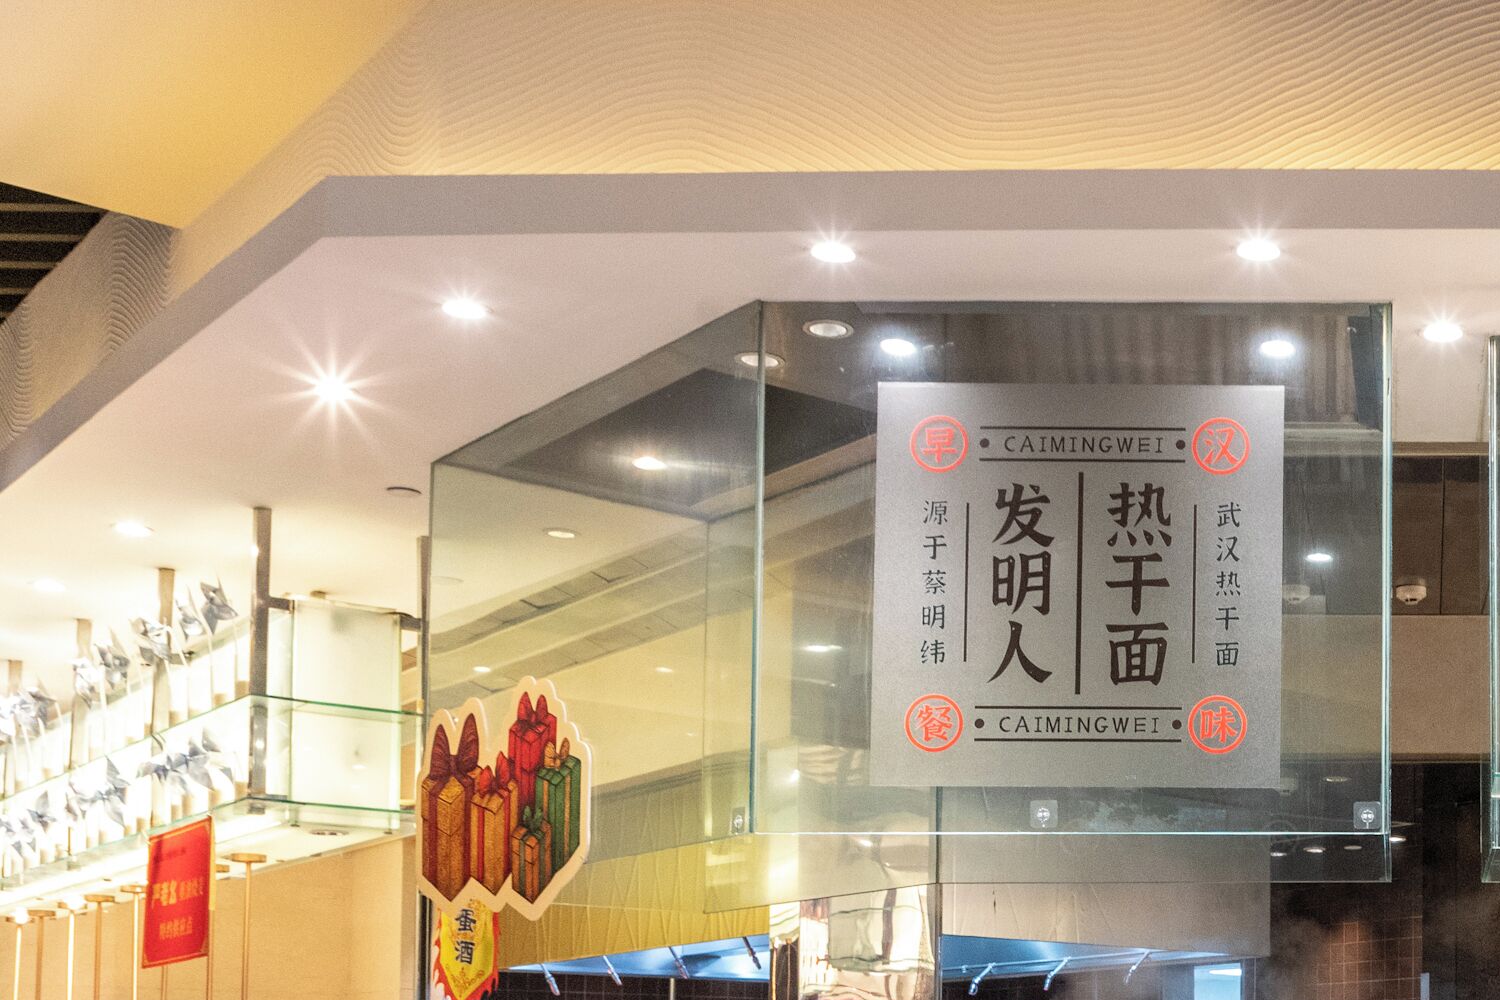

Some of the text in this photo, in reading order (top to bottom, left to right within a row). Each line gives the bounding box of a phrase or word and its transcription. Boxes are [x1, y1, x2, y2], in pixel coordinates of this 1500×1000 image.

[921, 427, 957, 464] 早
[1003, 434, 1165, 454] CAIMINGWEI
[1203, 428, 1236, 466] 汉
[920, 499, 948, 665] 源于蔡明纬
[987, 482, 1055, 684] 发明人
[1105, 481, 1172, 686] 热干面
[1214, 502, 1242, 667] 武汉热干面
[917, 705, 954, 743] 餐
[998, 715, 1160, 734] CAIMINGWEI
[1200, 705, 1237, 743] 味
[455, 908, 477, 964] 蛋酒
